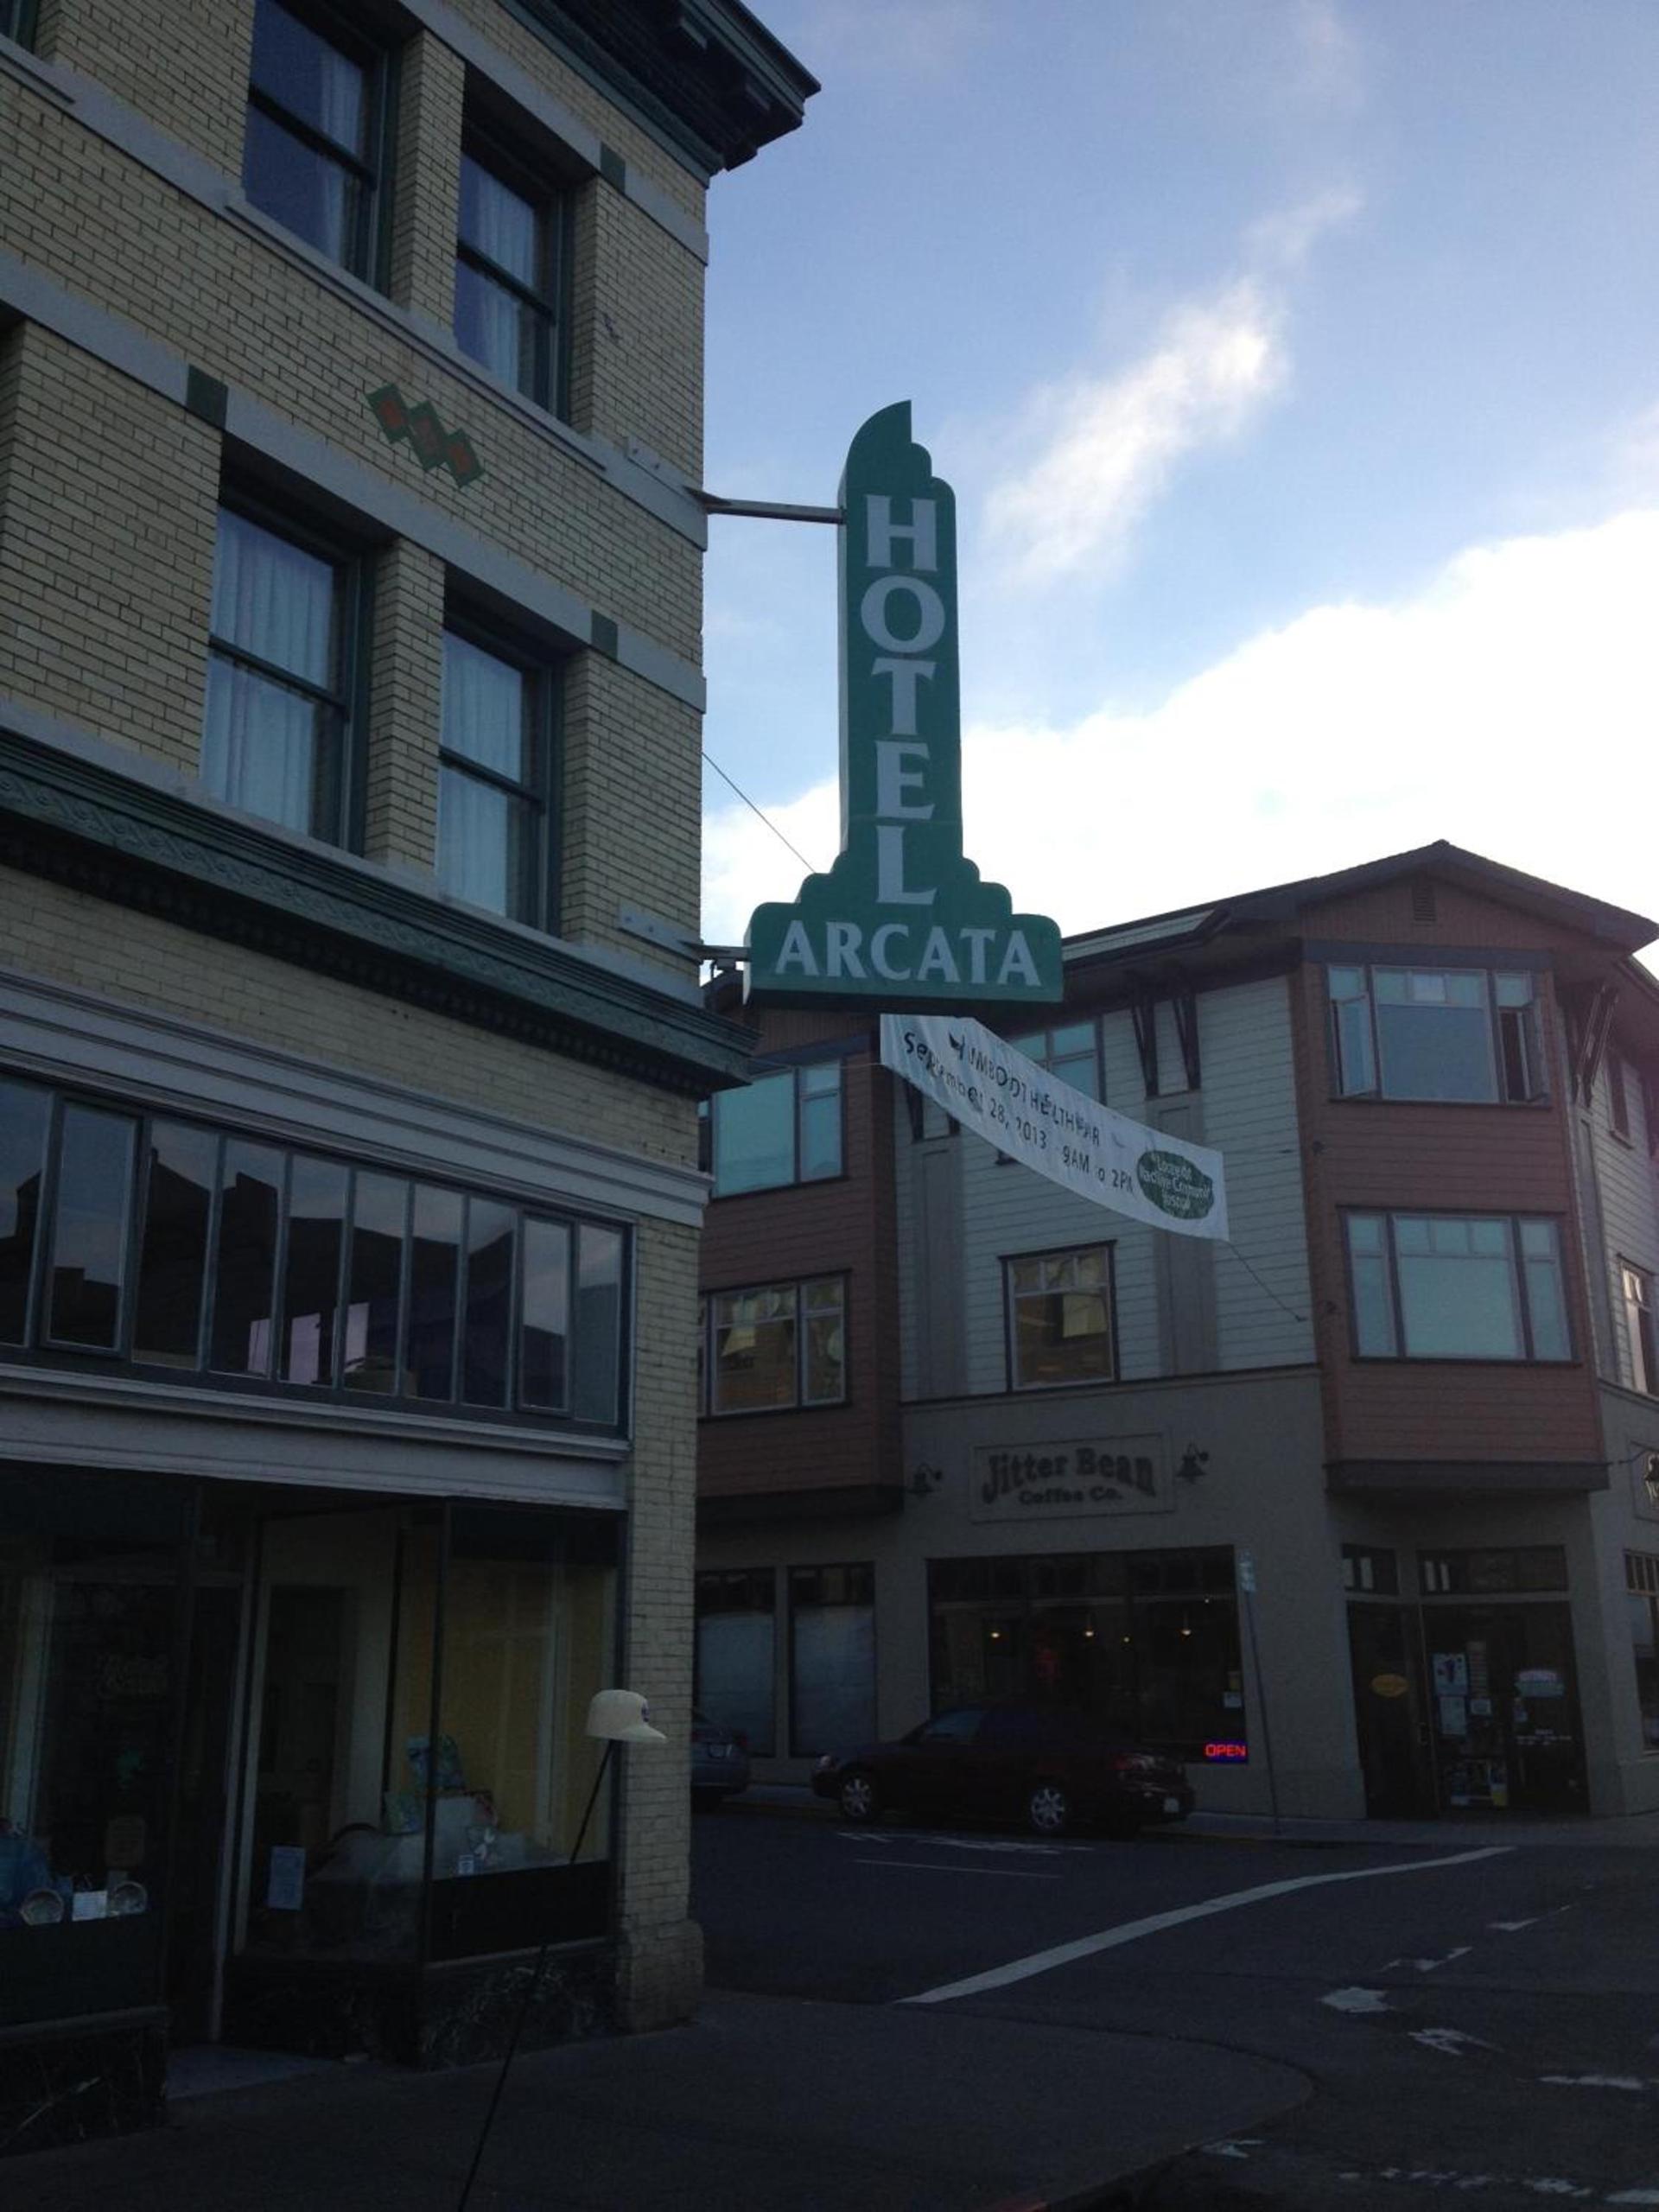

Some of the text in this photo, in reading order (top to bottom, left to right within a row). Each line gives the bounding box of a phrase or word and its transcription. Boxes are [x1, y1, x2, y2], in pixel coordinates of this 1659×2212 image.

[861, 494, 945, 906] HOTEL
[774, 918, 1042, 988] ARCATA
[903, 1031, 983, 1104] Sepember
[1063, 1145, 1090, 1174] 9AM
[949, 1030, 1027, 1103] HUMBODT
[1031, 1090, 1075, 1133] HELTH
[982, 1446, 1157, 1504] Jitter Bean
[1018, 1485, 1123, 1505] Coffee Co.
[1205, 1744, 1246, 1757] OPEN
